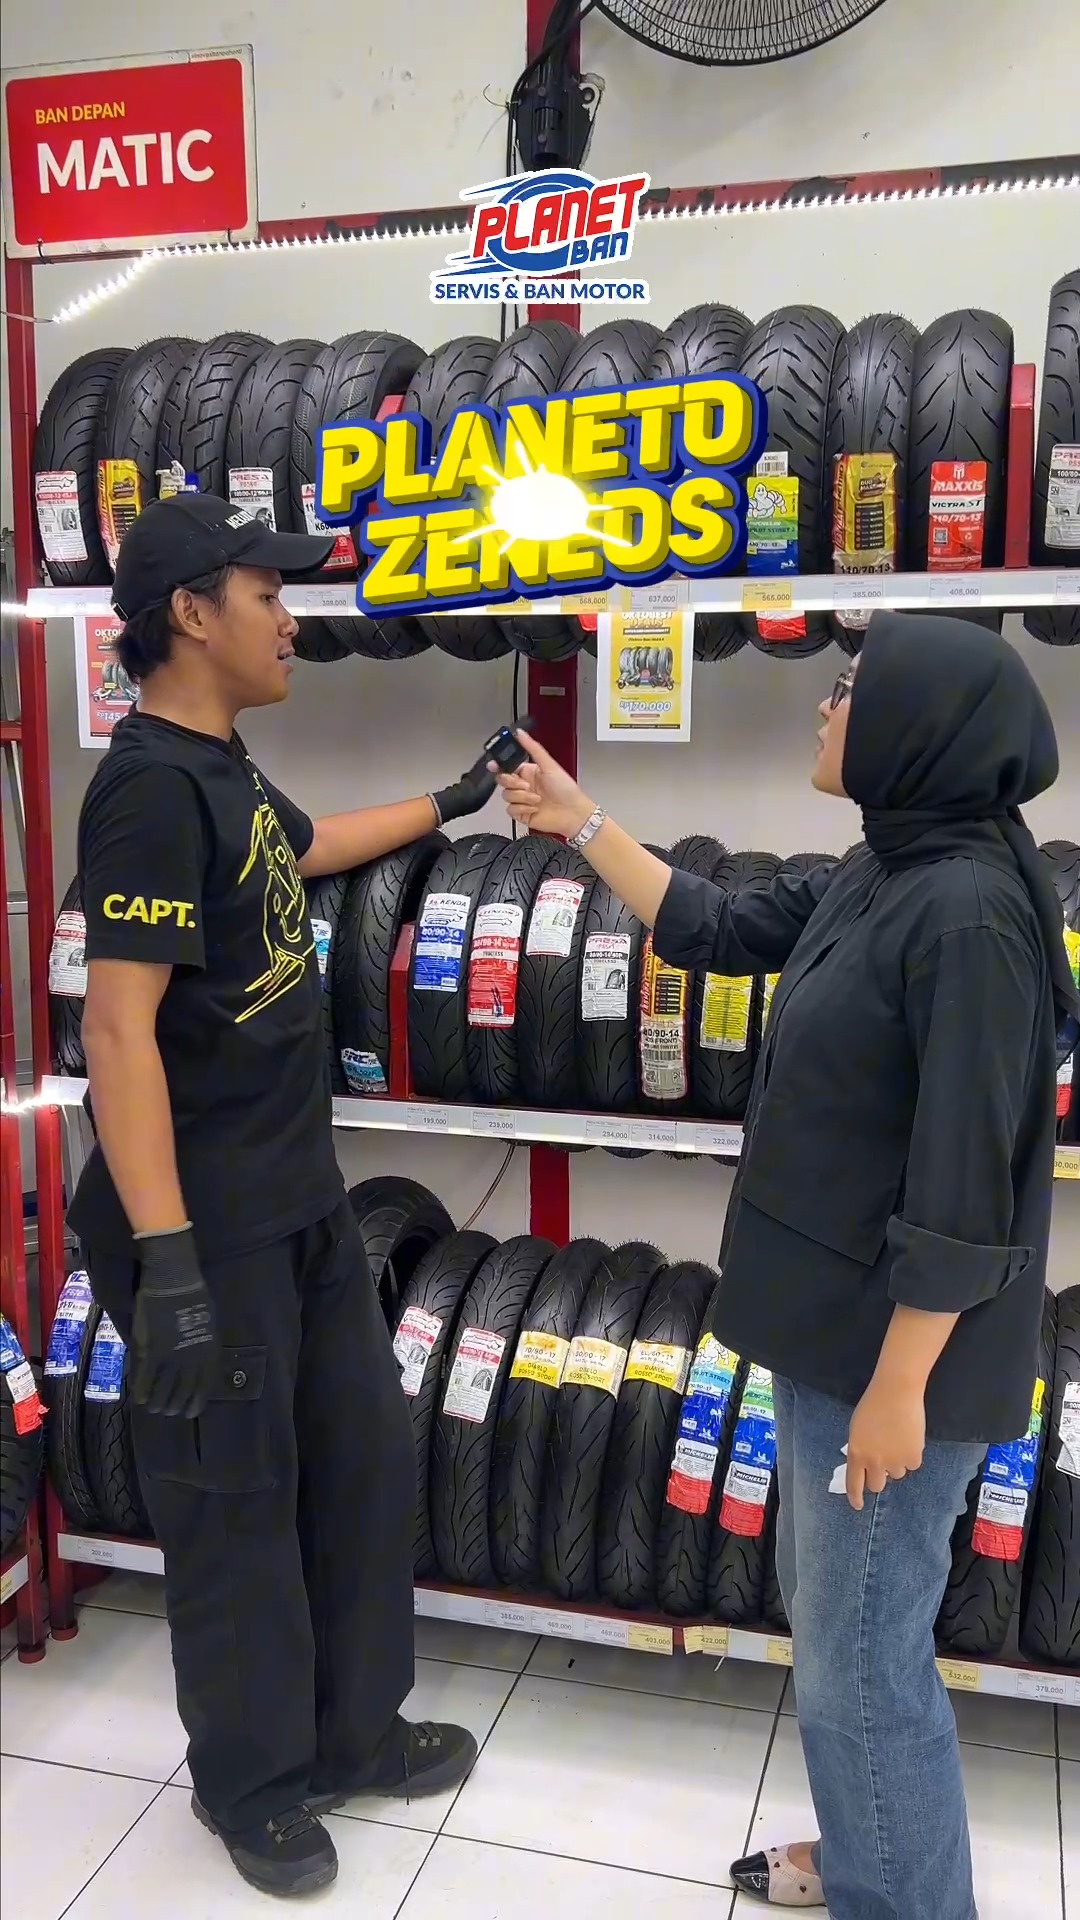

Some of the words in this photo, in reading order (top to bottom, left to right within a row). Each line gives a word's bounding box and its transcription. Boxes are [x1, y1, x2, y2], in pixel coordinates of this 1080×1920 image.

[35, 106, 68, 125] BAN
[72, 101, 126, 121] DEPAN
[37, 129, 215, 194] MATIC
[933, 480, 983, 492] MAXXIS
[967, 500, 982, 508] ST
[648, 595, 676, 603] 637,000
[440, 899, 467, 907] KENDA
[103, 893, 197, 929] CAPT.
[712, 1137, 739, 1146] 322,000
[1053, 1160, 1078, 1170] 30,000
[709, 1372, 731, 1384] STREET
[736, 1472, 767, 1485] MICHELIN
